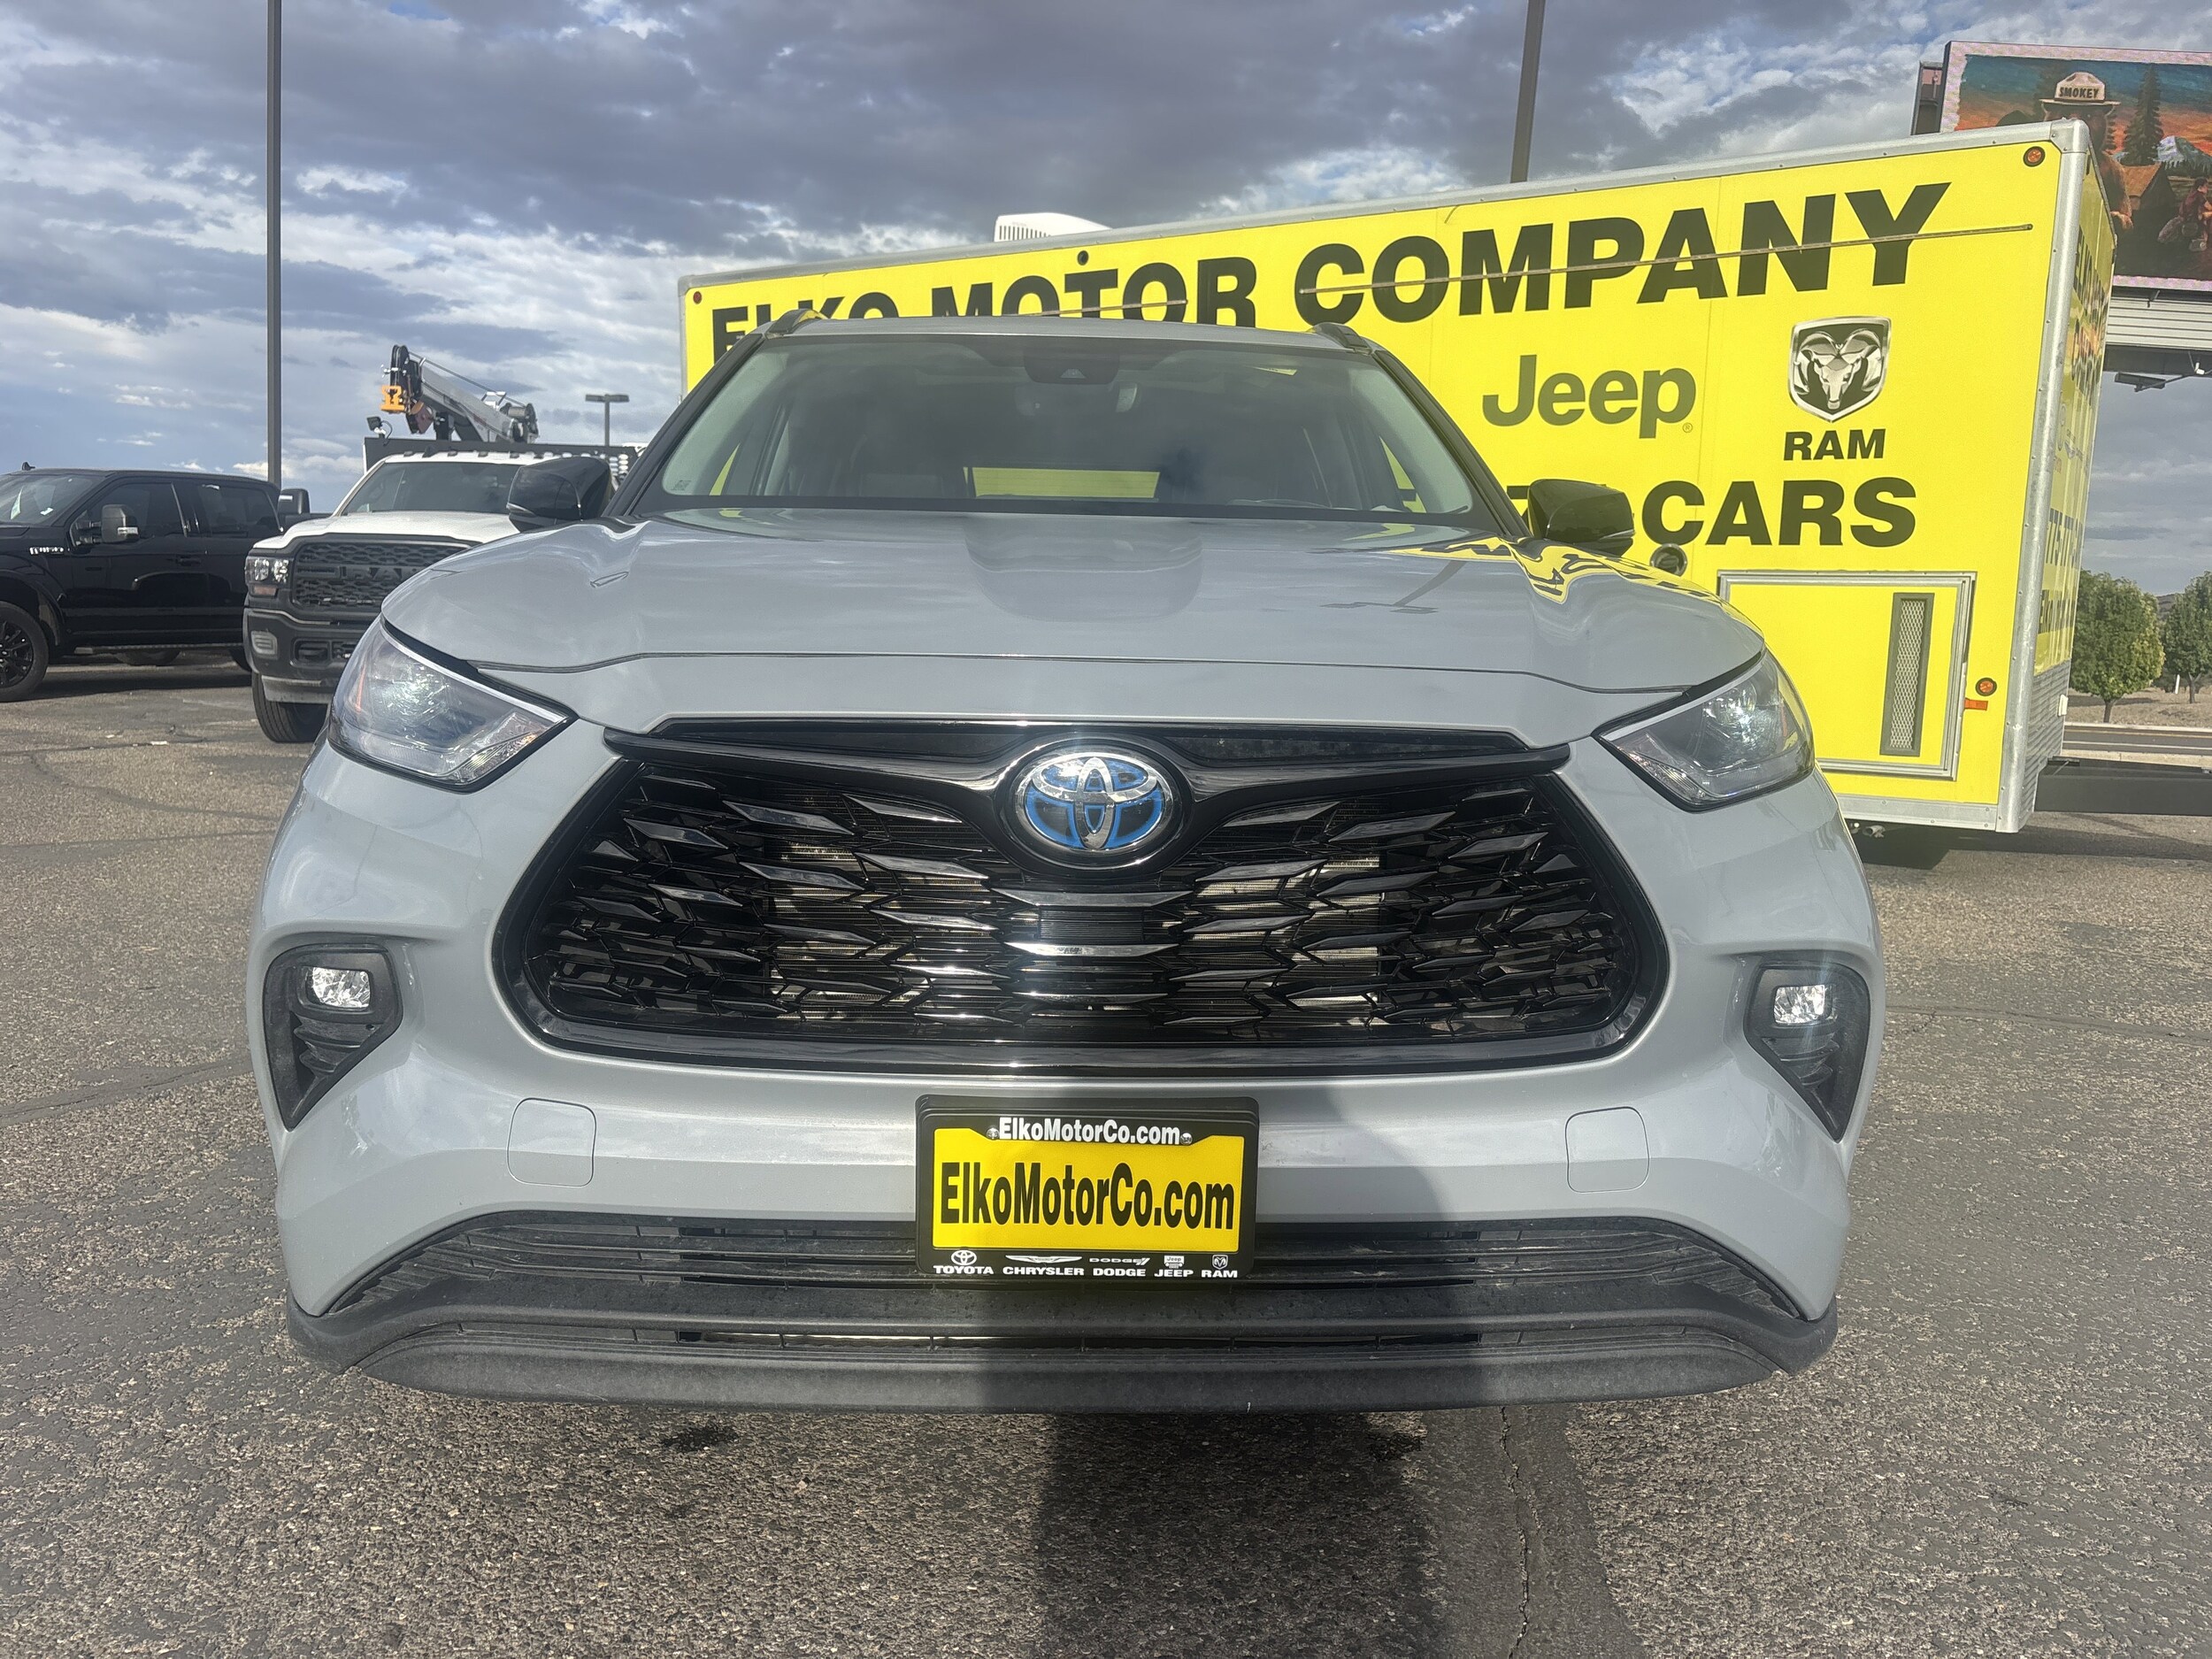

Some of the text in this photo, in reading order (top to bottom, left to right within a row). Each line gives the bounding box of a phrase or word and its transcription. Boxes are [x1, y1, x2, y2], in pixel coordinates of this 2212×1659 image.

[2058, 86, 2100, 99] SMOKEY
[1294, 182, 1952, 325] COMPANY
[1482, 354, 1696, 439] Jeep
[1783, 428, 1886, 461] RAM
[1641, 477, 1916, 547] CARS
[998, 1117, 1180, 1145] ElkoMotorCo.com
[940, 1161, 1234, 1230] ElkoMotorCo.com
[933, 1265, 1238, 1279] TOYOTA CHRYSLER DODGE JEEP RAM
